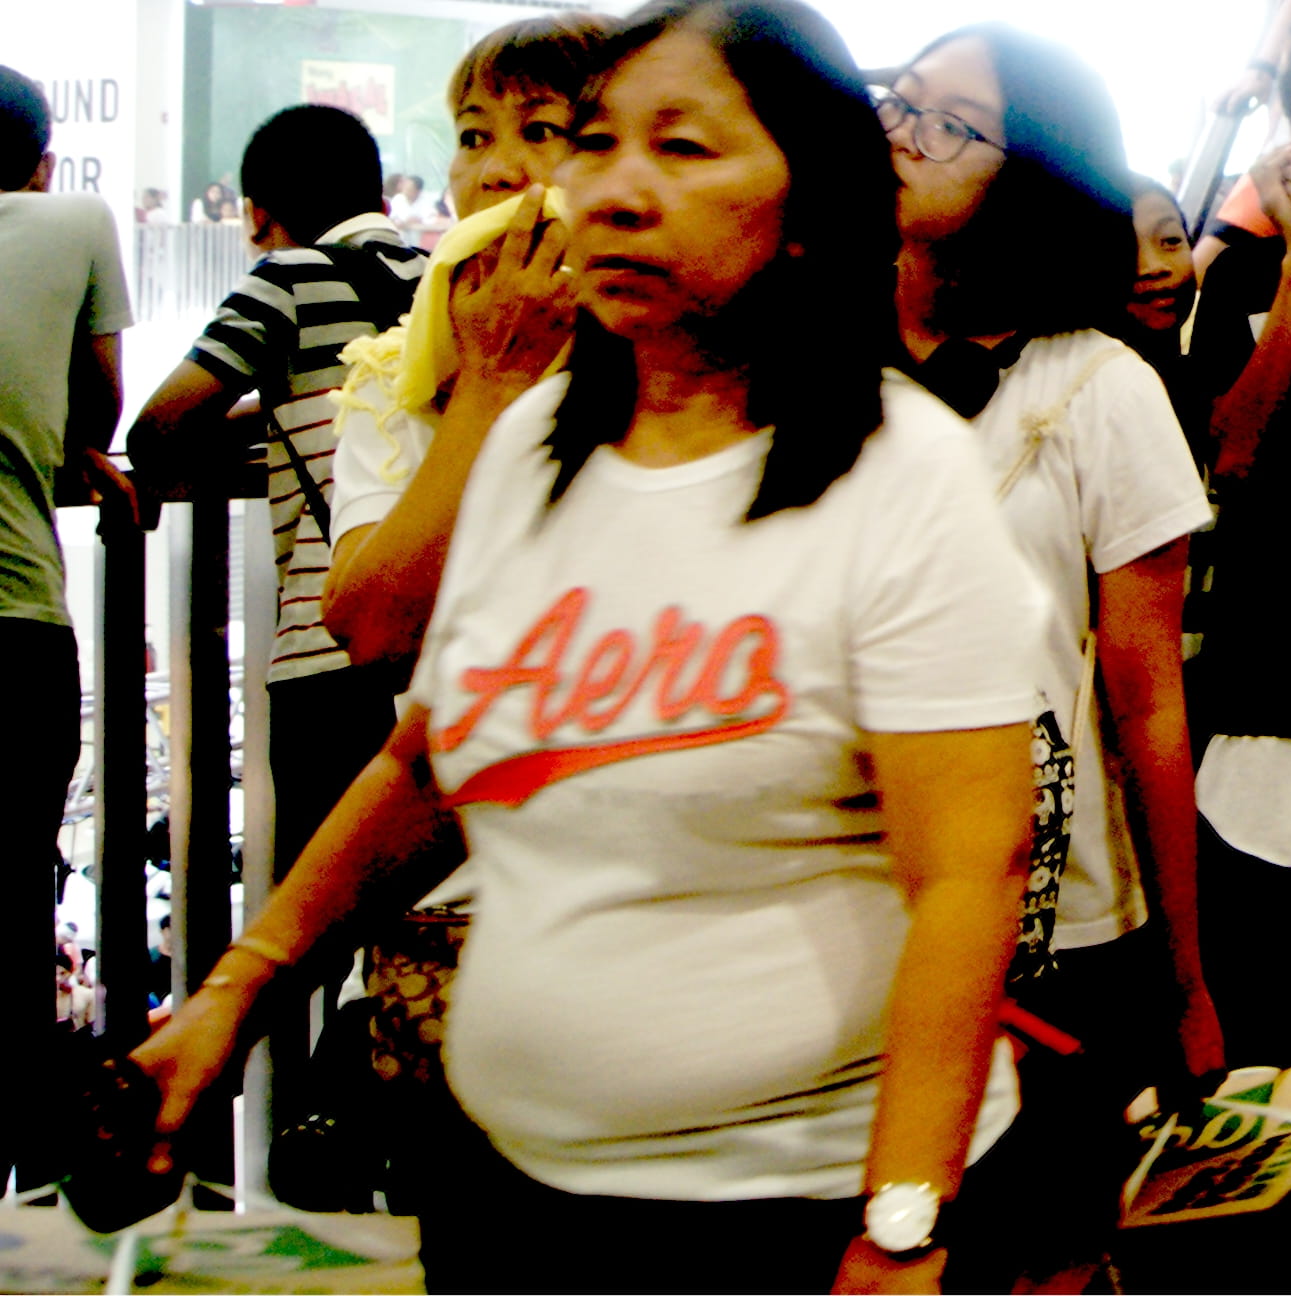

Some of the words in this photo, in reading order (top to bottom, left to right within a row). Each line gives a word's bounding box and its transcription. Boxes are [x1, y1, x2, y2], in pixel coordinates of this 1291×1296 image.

[34, 78, 119, 124] UND
[58, 156, 102, 193] OR
[431, 586, 790, 752] Aero
